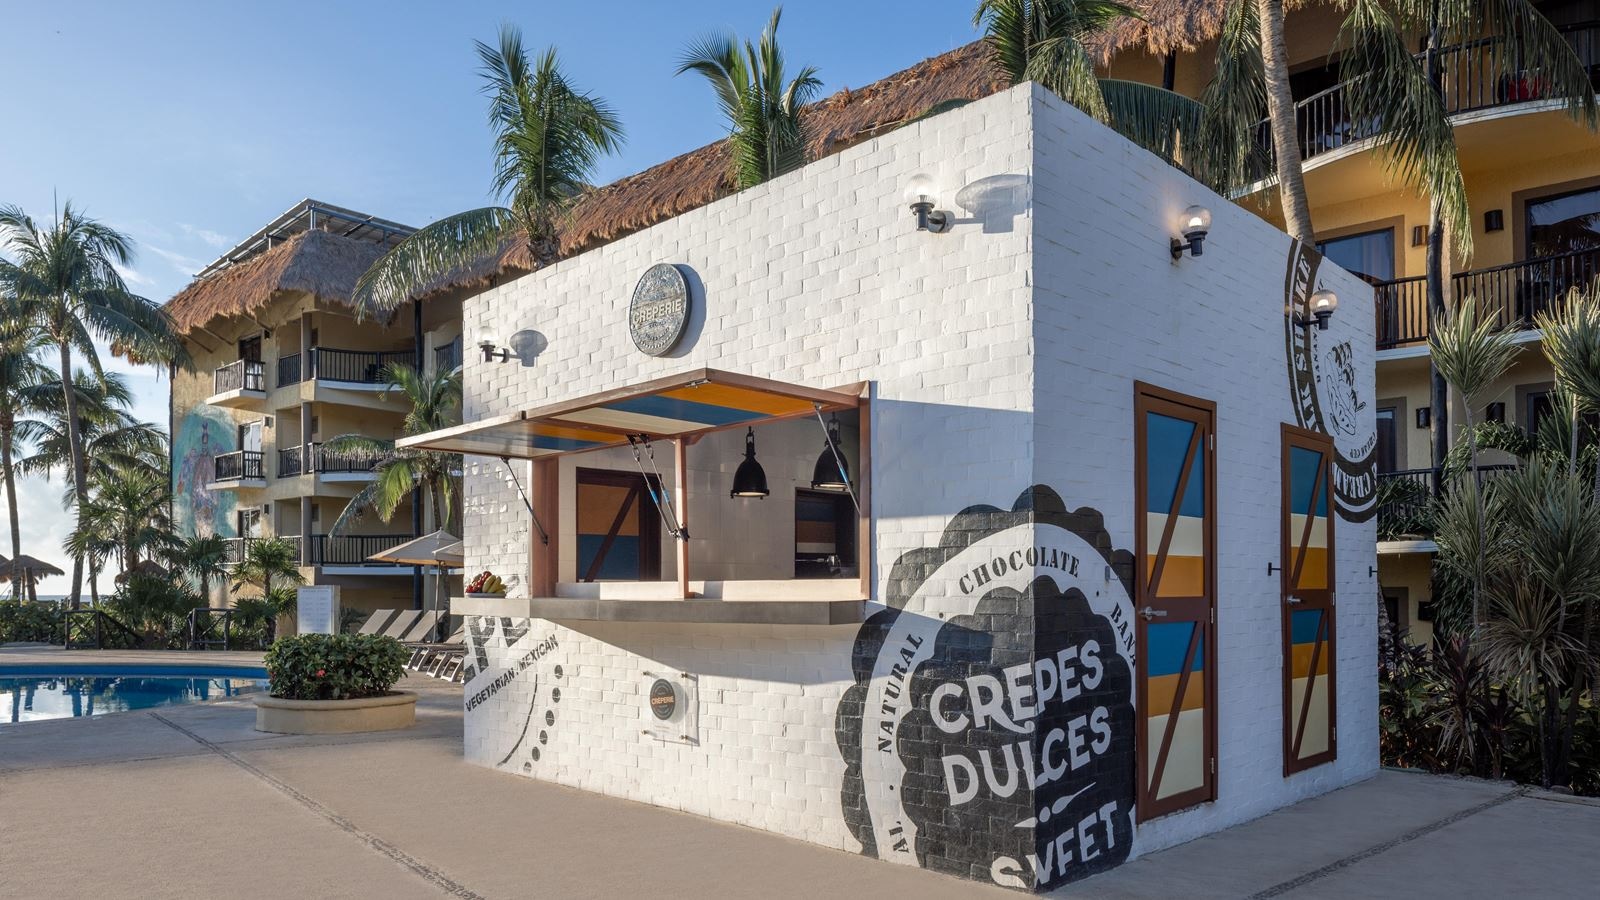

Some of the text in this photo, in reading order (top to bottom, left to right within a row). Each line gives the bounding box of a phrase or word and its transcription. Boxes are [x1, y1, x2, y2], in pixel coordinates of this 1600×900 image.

[633, 299, 682, 324] CREPERIE
[1332, 462, 1370, 498] CREAM
[959, 546, 1080, 595] CHOCOLATE
[519, 633, 559, 671] MEXICAN
[878, 633, 924, 754] NATURAL
[929, 639, 1104, 734] CREPES
[941, 706, 1112, 806] DULCES
